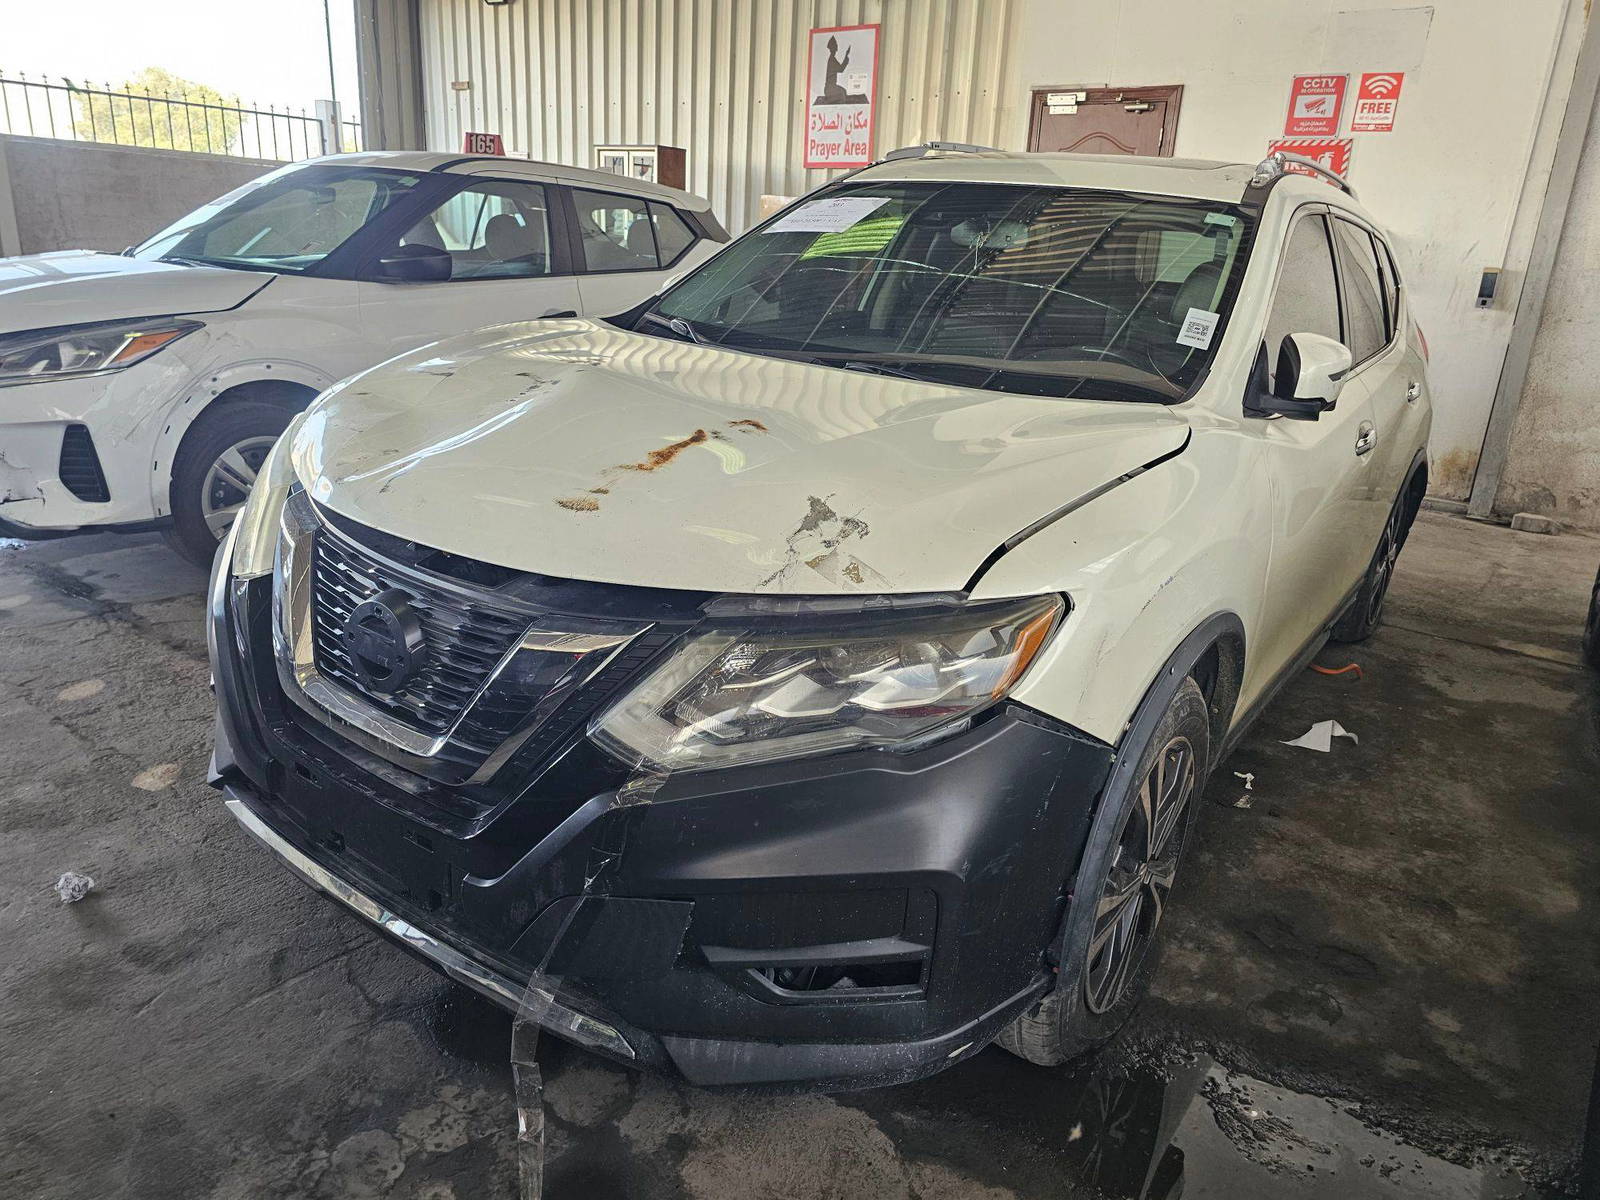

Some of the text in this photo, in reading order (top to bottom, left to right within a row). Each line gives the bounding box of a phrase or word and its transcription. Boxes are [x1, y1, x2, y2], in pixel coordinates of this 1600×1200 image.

[1303, 78, 1337, 88] CCTV
[1360, 102, 1392, 114] FREE
[811, 110, 868, 135] مكان الصلاة
[470, 134, 494, 154] 165
[810, 138, 867, 160] Prayer Area
